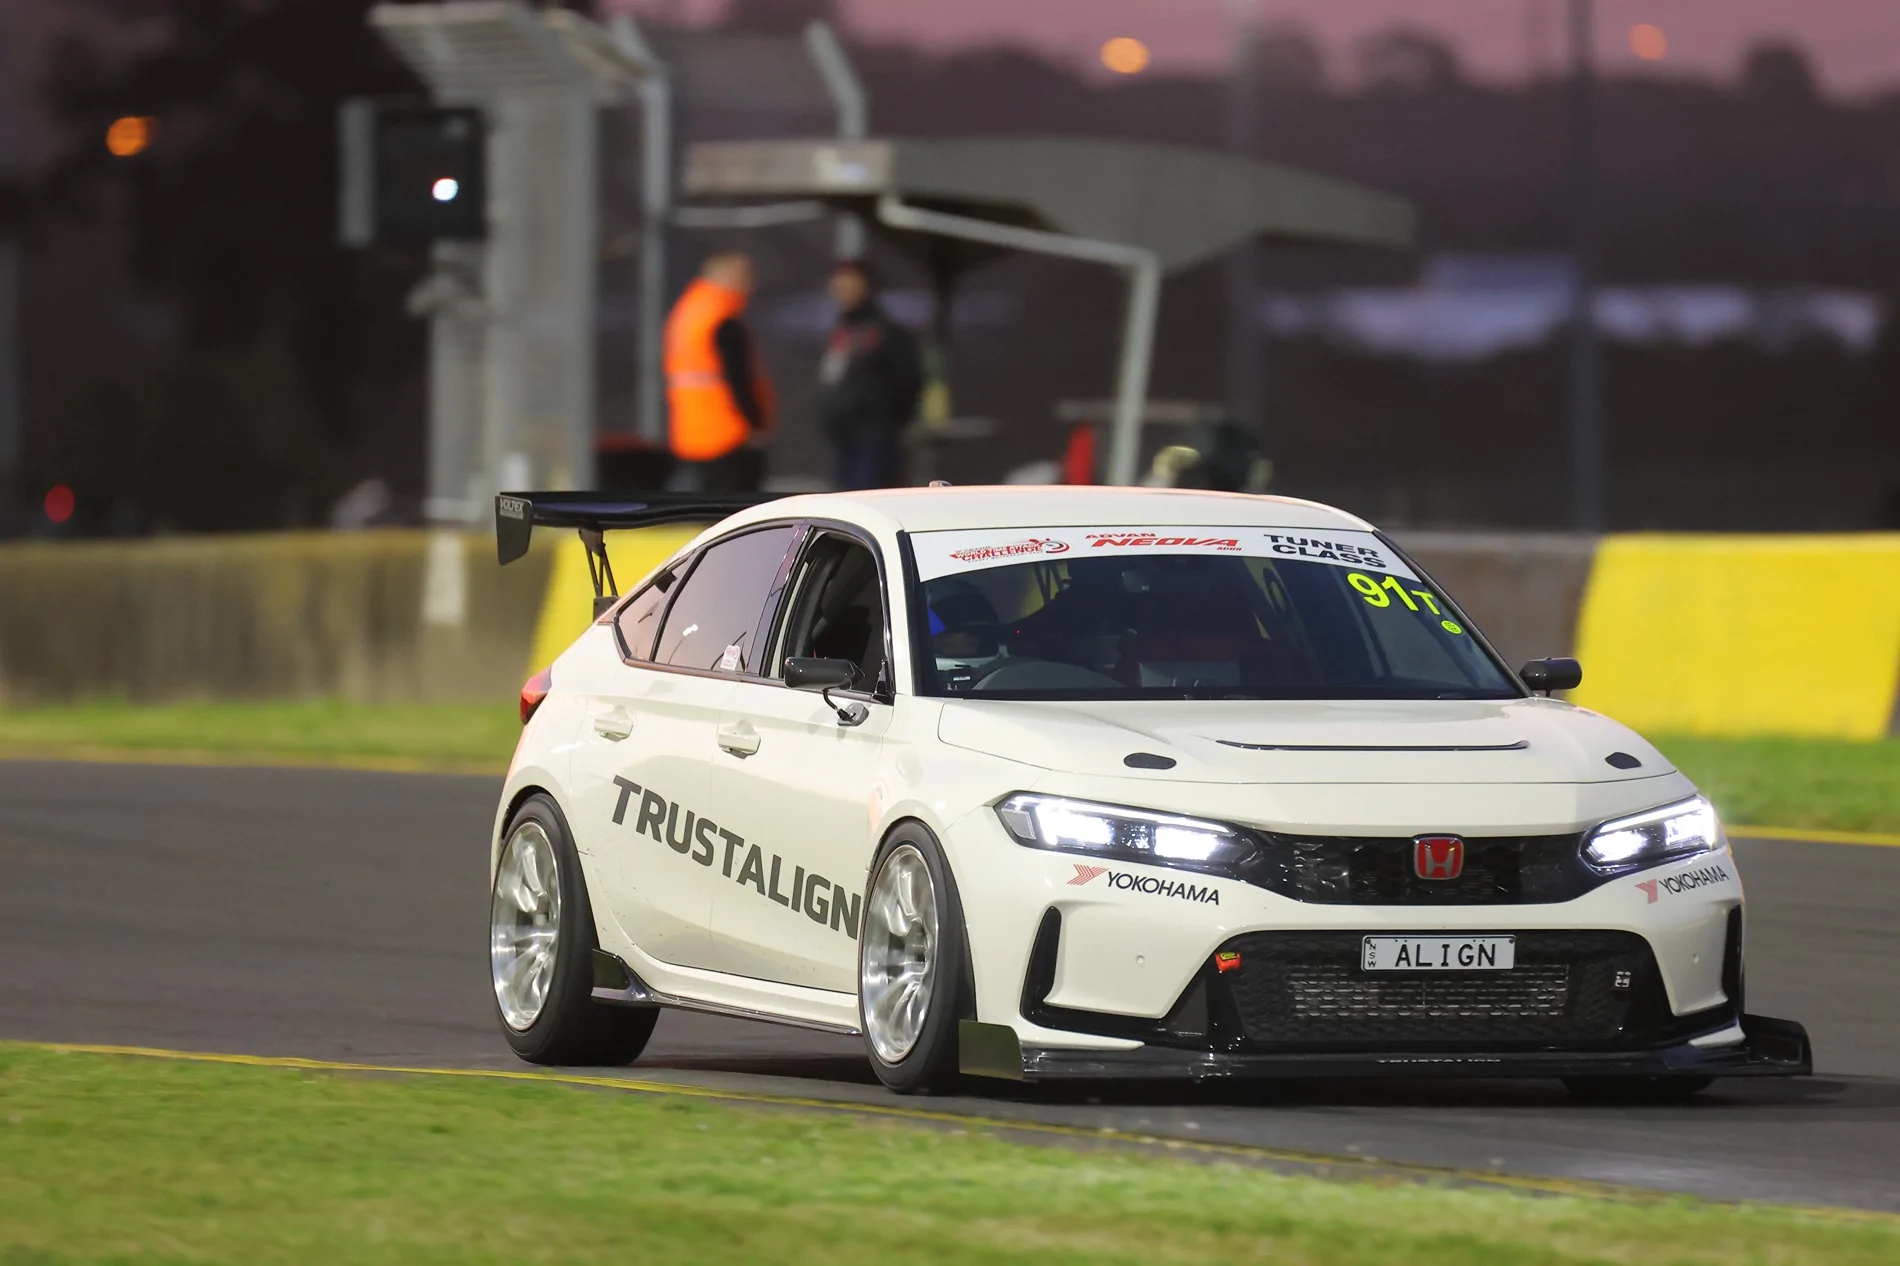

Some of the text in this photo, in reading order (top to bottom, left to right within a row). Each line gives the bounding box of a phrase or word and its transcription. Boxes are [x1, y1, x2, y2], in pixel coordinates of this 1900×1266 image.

[500, 498, 523, 513] VOLTEX
[1091, 538, 1239, 547] NEOVA
[1263, 534, 1379, 558] TUNER
[1272, 544, 1387, 568] CLASS
[612, 775, 861, 940] TRUSTALIGN
[1108, 871, 1219, 905] YOKOHAMA
[1659, 865, 1730, 895] YOKOHAMA
[1395, 944, 1496, 967] ALIGN
